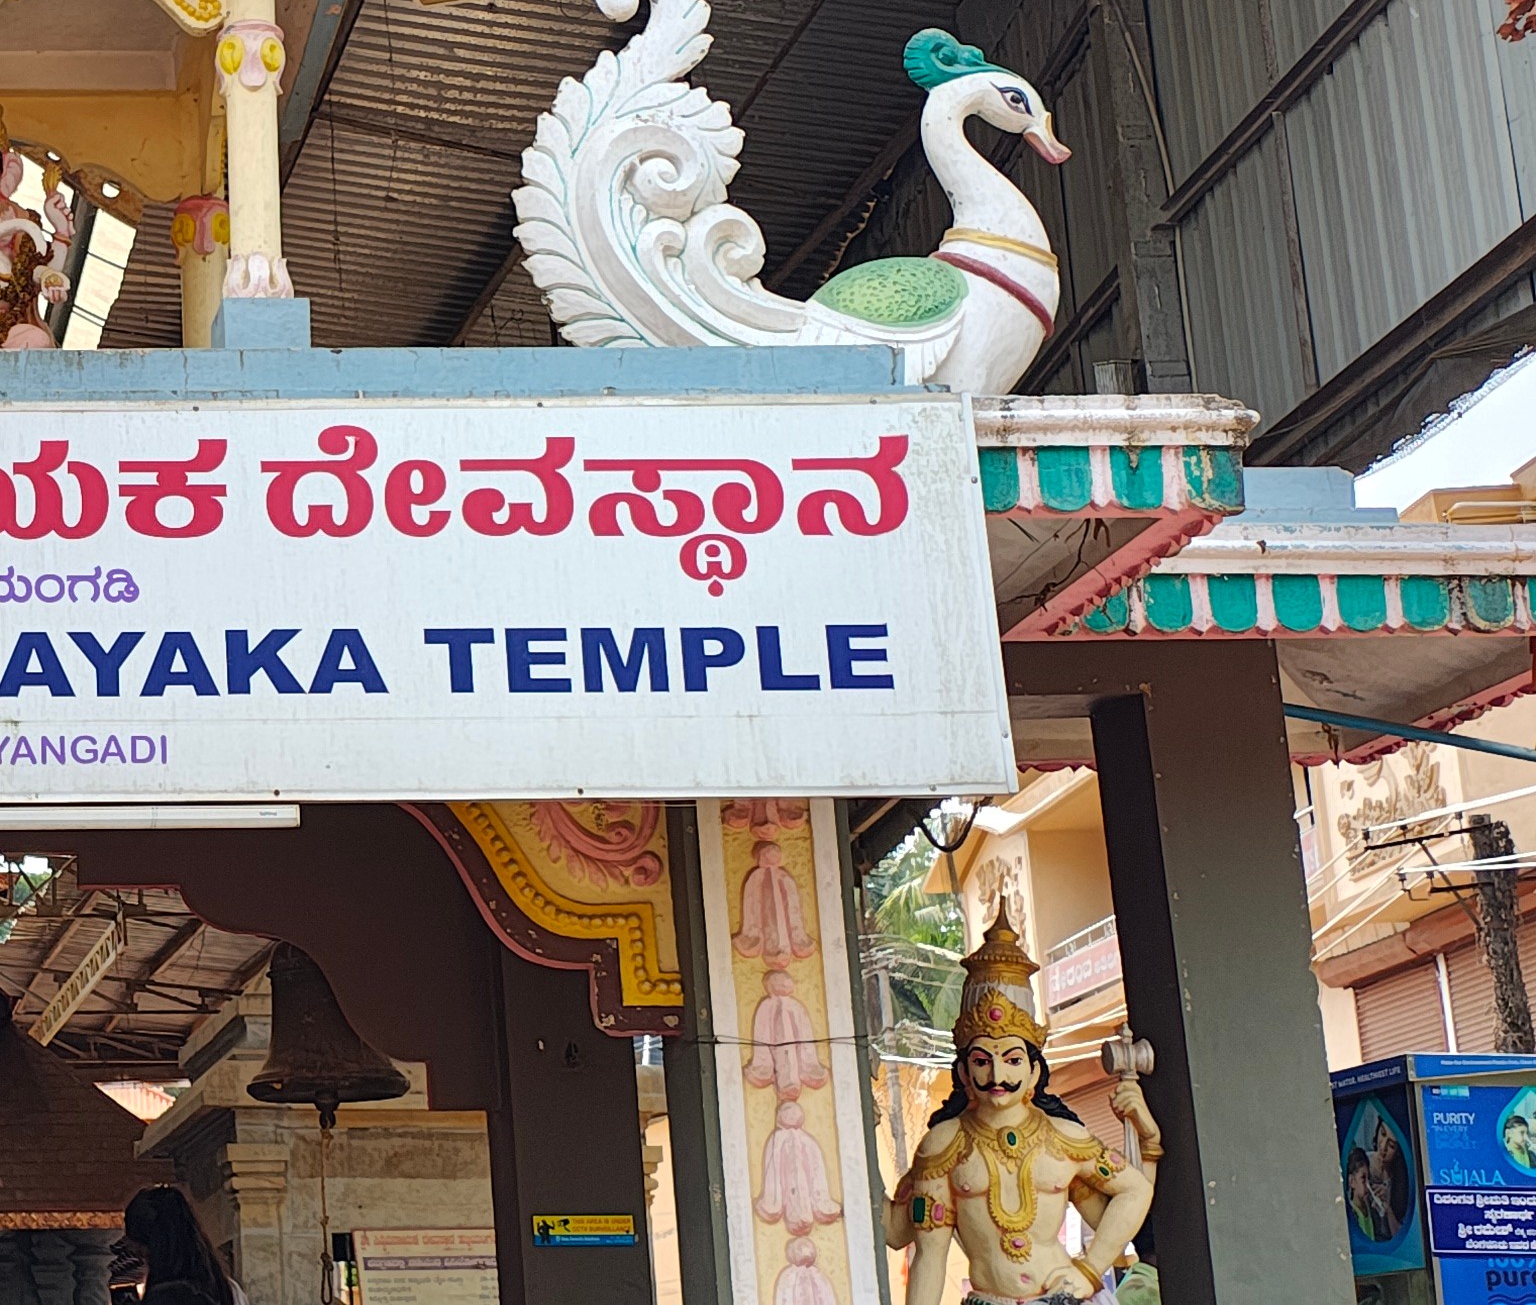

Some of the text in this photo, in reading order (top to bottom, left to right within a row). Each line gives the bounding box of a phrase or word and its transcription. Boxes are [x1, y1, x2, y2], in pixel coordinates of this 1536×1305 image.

[260, 425, 910, 598] ದೇವಸ್ಥಾನ
[424, 624, 895, 694] TEMPLE
[1433, 1112, 1475, 1125] PURITY
[1439, 1168, 1506, 1186] SUJALA
[1485, 1269, 1536, 1291] pur
